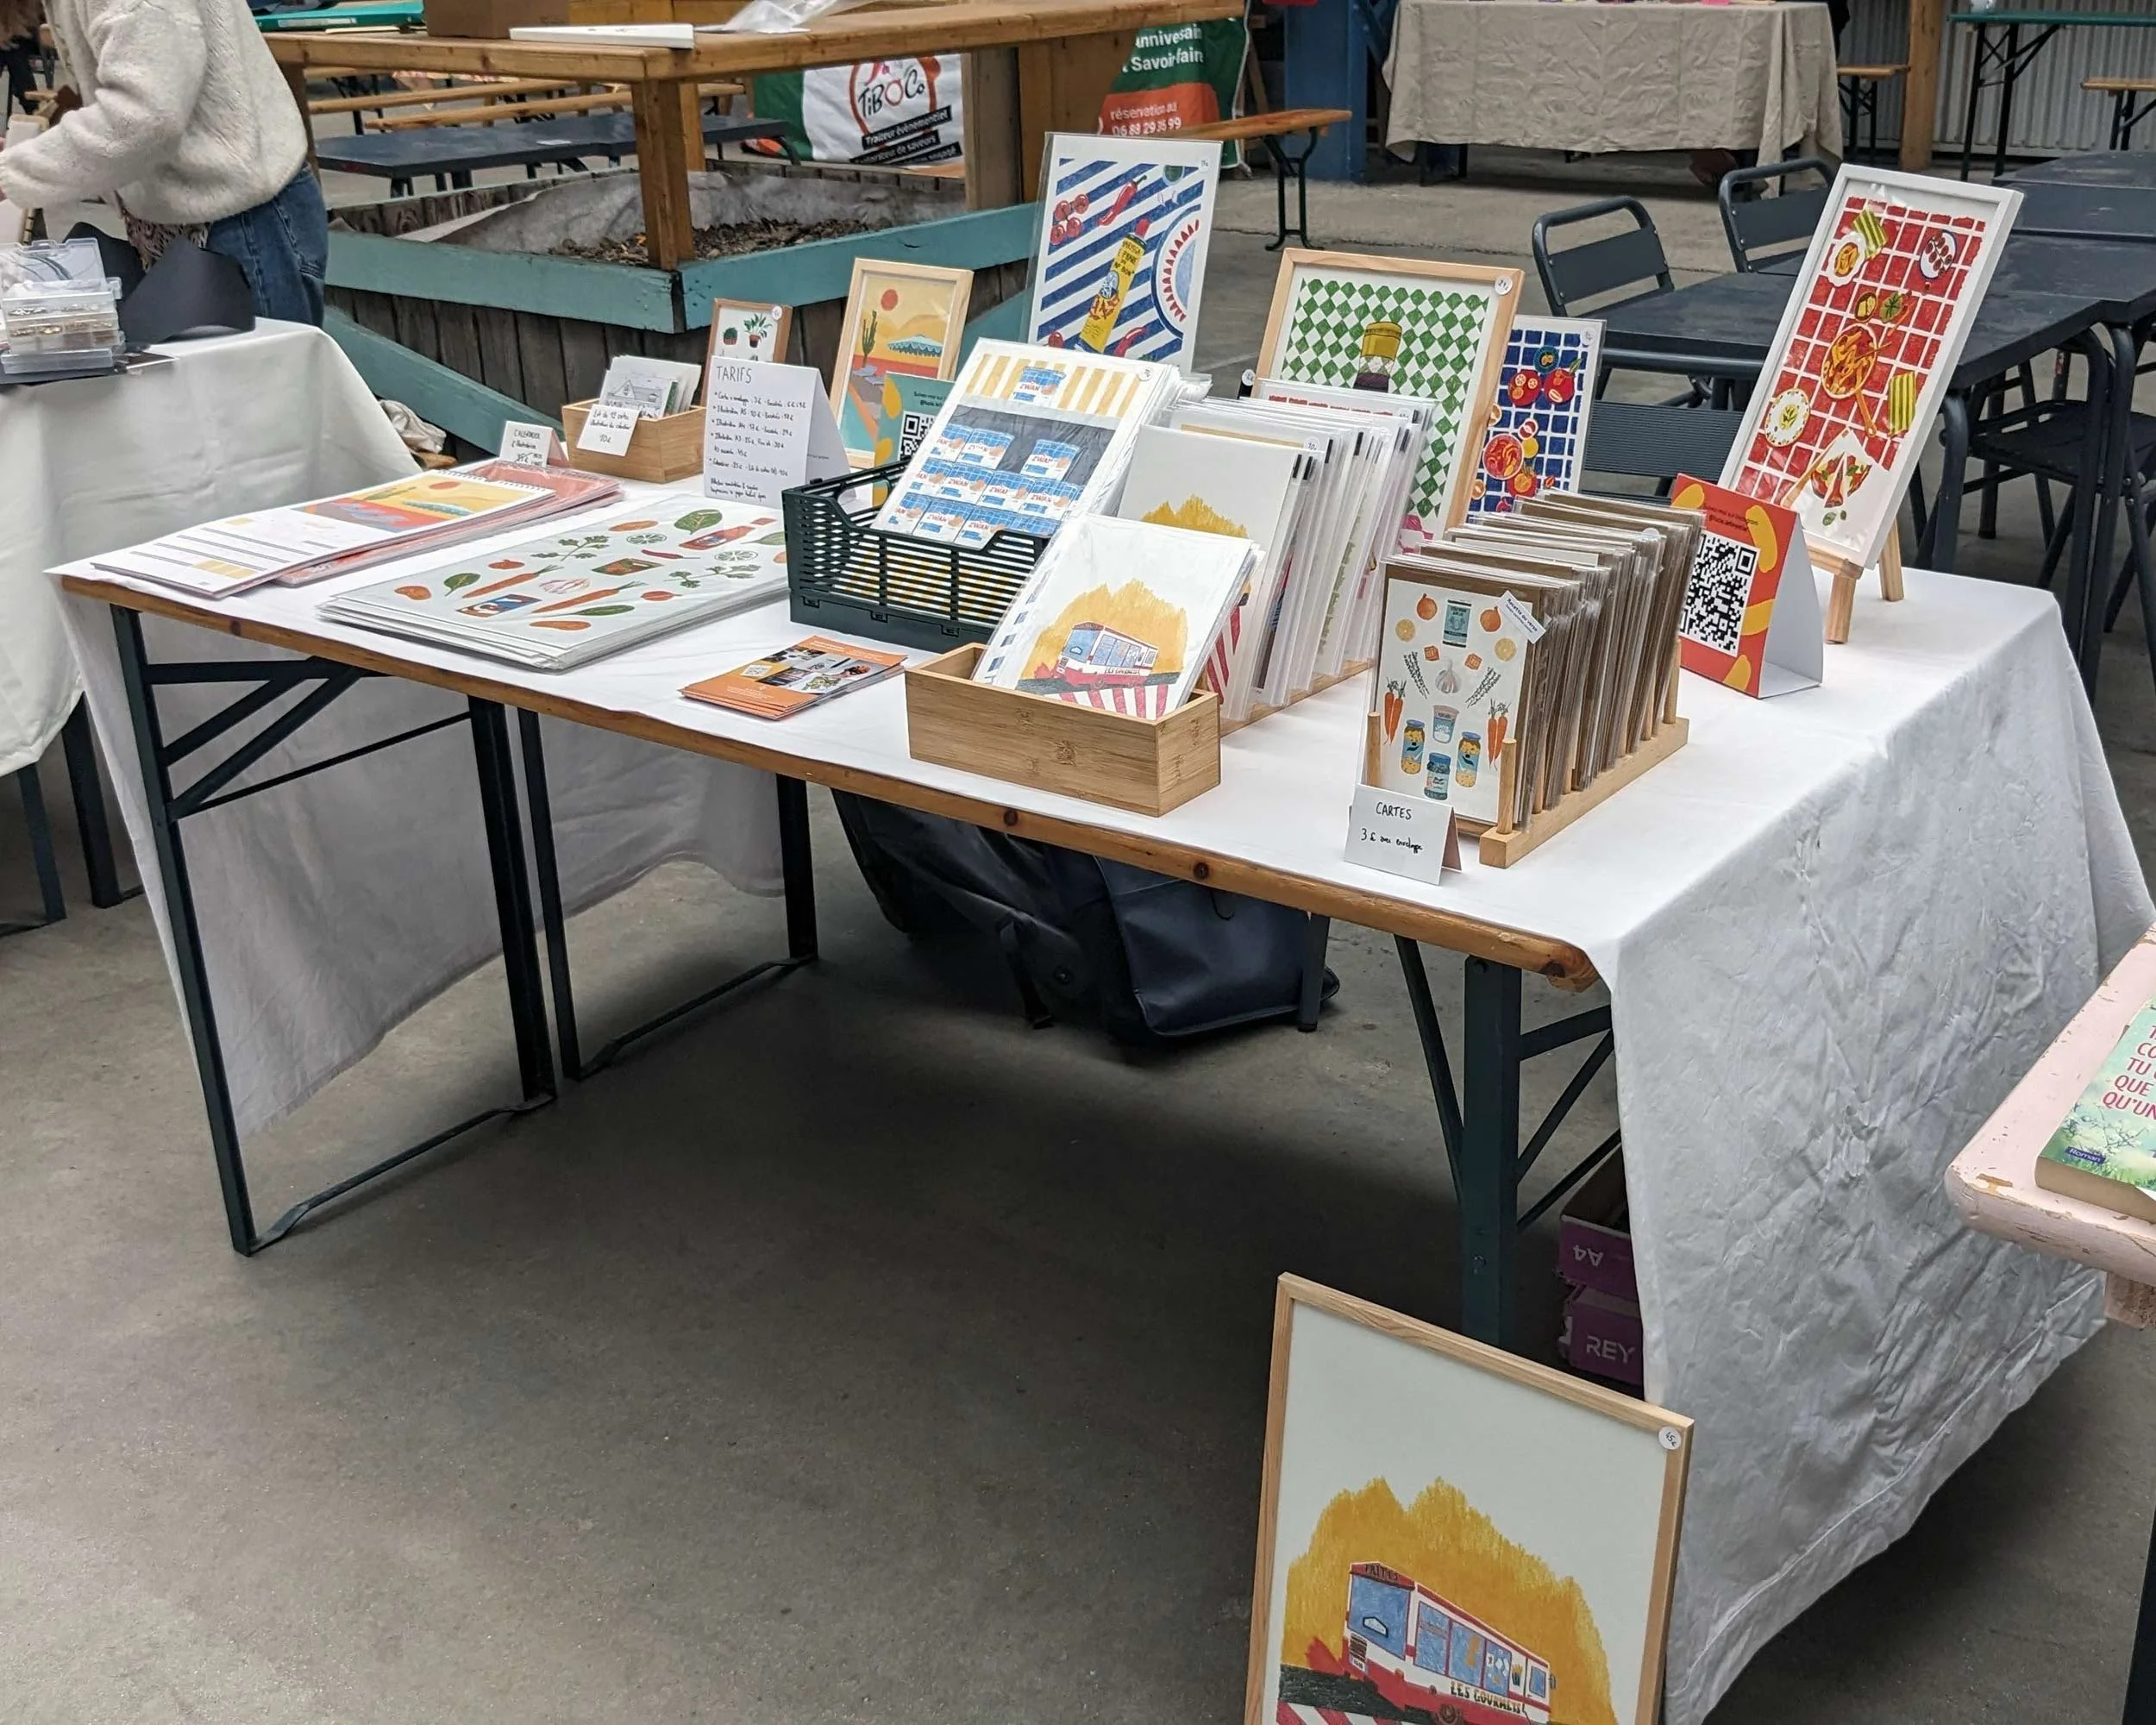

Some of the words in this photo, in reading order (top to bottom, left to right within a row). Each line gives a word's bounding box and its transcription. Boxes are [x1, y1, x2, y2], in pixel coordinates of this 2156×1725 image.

[1167, 117, 1181, 130] 99
[717, 366, 752, 384] TARIFS
[968, 522, 989, 530] ZWAN
[1376, 801, 1412, 820] CARTES
[1361, 828, 1367, 841] 3
[2127, 1057, 2152, 1076] TU
[2115, 1075, 2154, 1097] QUE
[2069, 1148, 2102, 1163] Roman
[1572, 1244, 1604, 1267] A4
[1586, 1334, 1636, 1364] REY
[1450, 1681, 1470, 1699] LES
